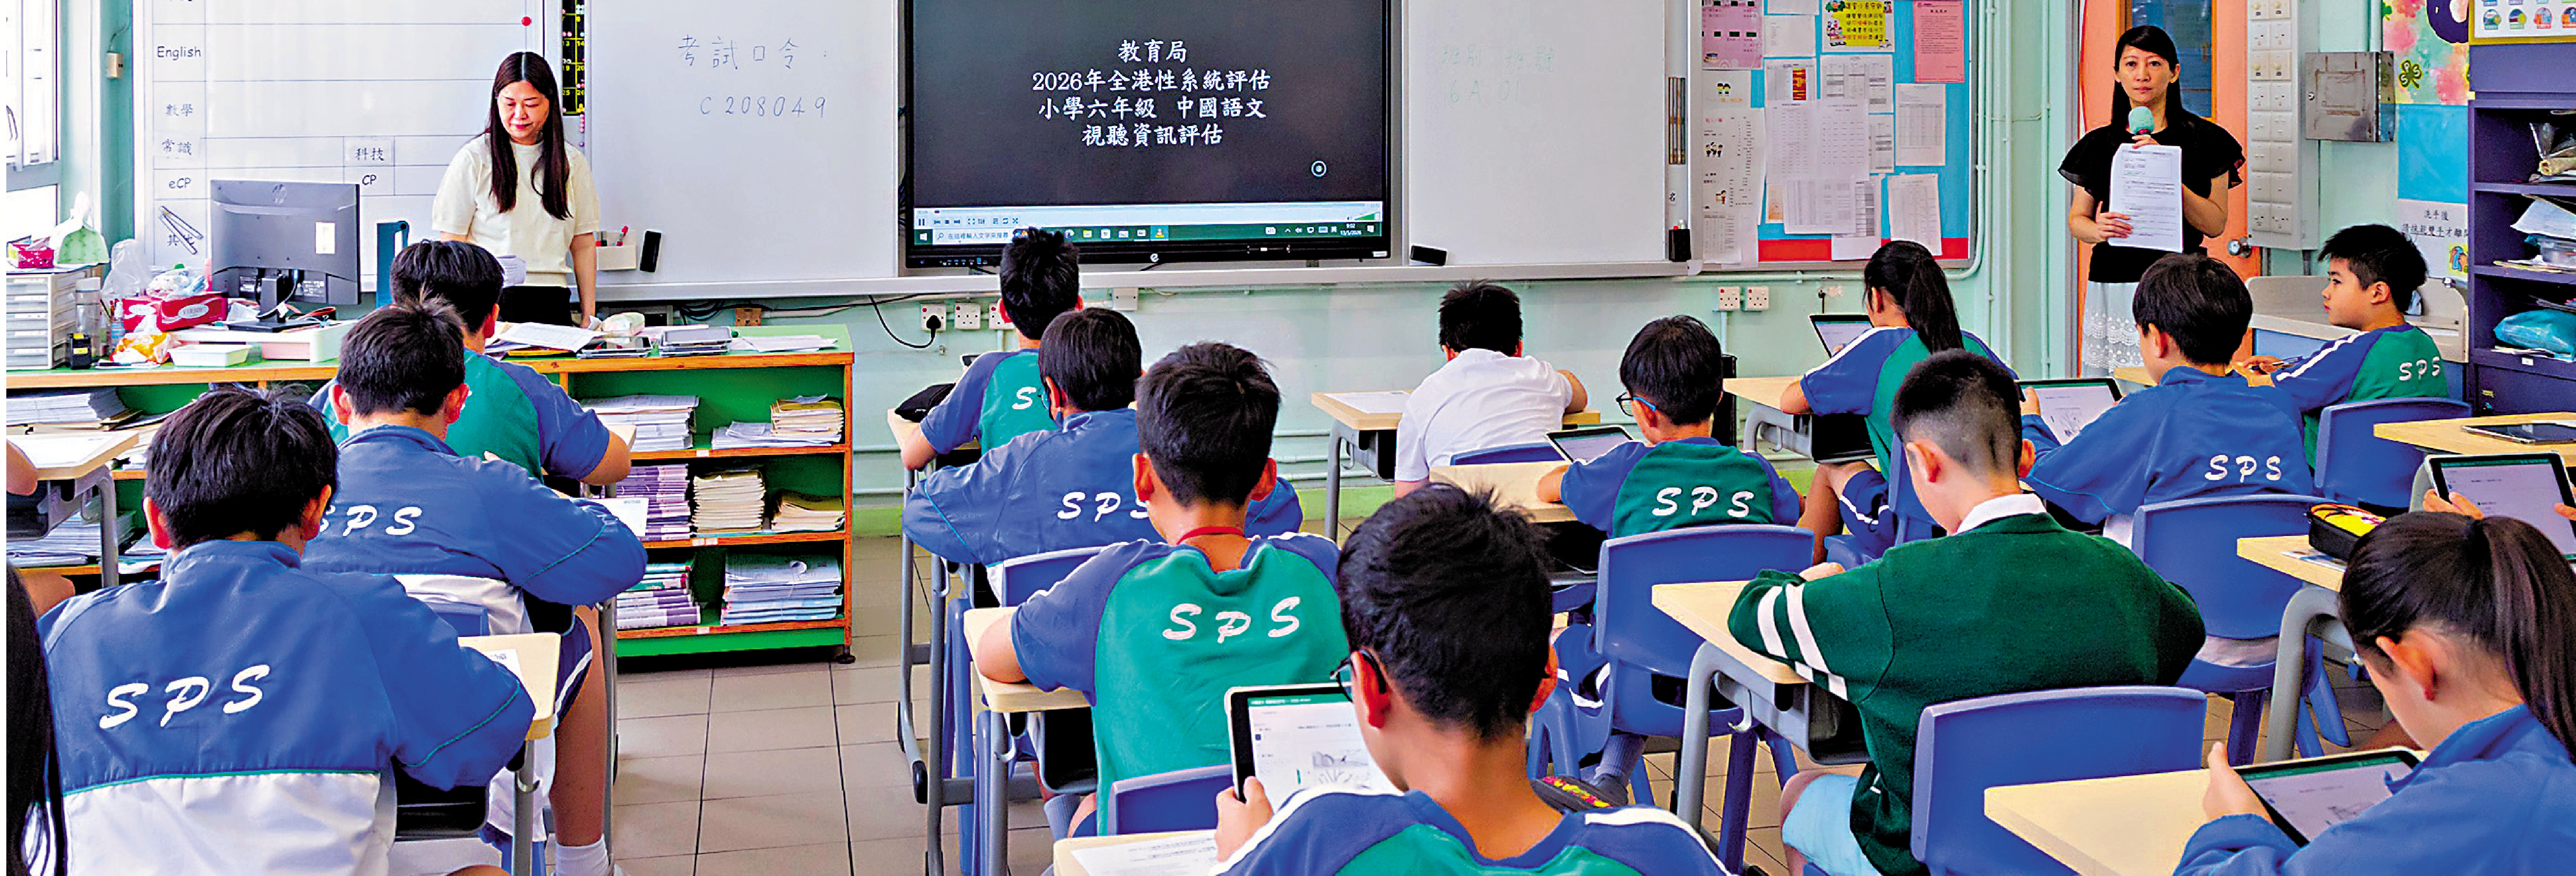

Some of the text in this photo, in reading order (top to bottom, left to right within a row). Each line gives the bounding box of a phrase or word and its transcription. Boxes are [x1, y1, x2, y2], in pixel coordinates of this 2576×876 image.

[157, 46, 201, 60] English
[1118, 38, 1187, 63] 教育局
[1032, 68, 1271, 92] 2026年全港性系統評估
[1039, 95, 1266, 120] 小學六年級 中國語文
[161, 138, 192, 156] 常識
[1082, 122, 1223, 147] 視聽資訊評估
[355, 147, 385, 162] 科技
[169, 177, 191, 189] eCP
[362, 175, 377, 186] CP
[2398, 356, 2441, 381] SPS
[2204, 454, 2282, 483] SPS
[1652, 486, 1754, 517] SPS
[1162, 596, 1301, 644] SPS
[99, 664, 270, 729] SPS
